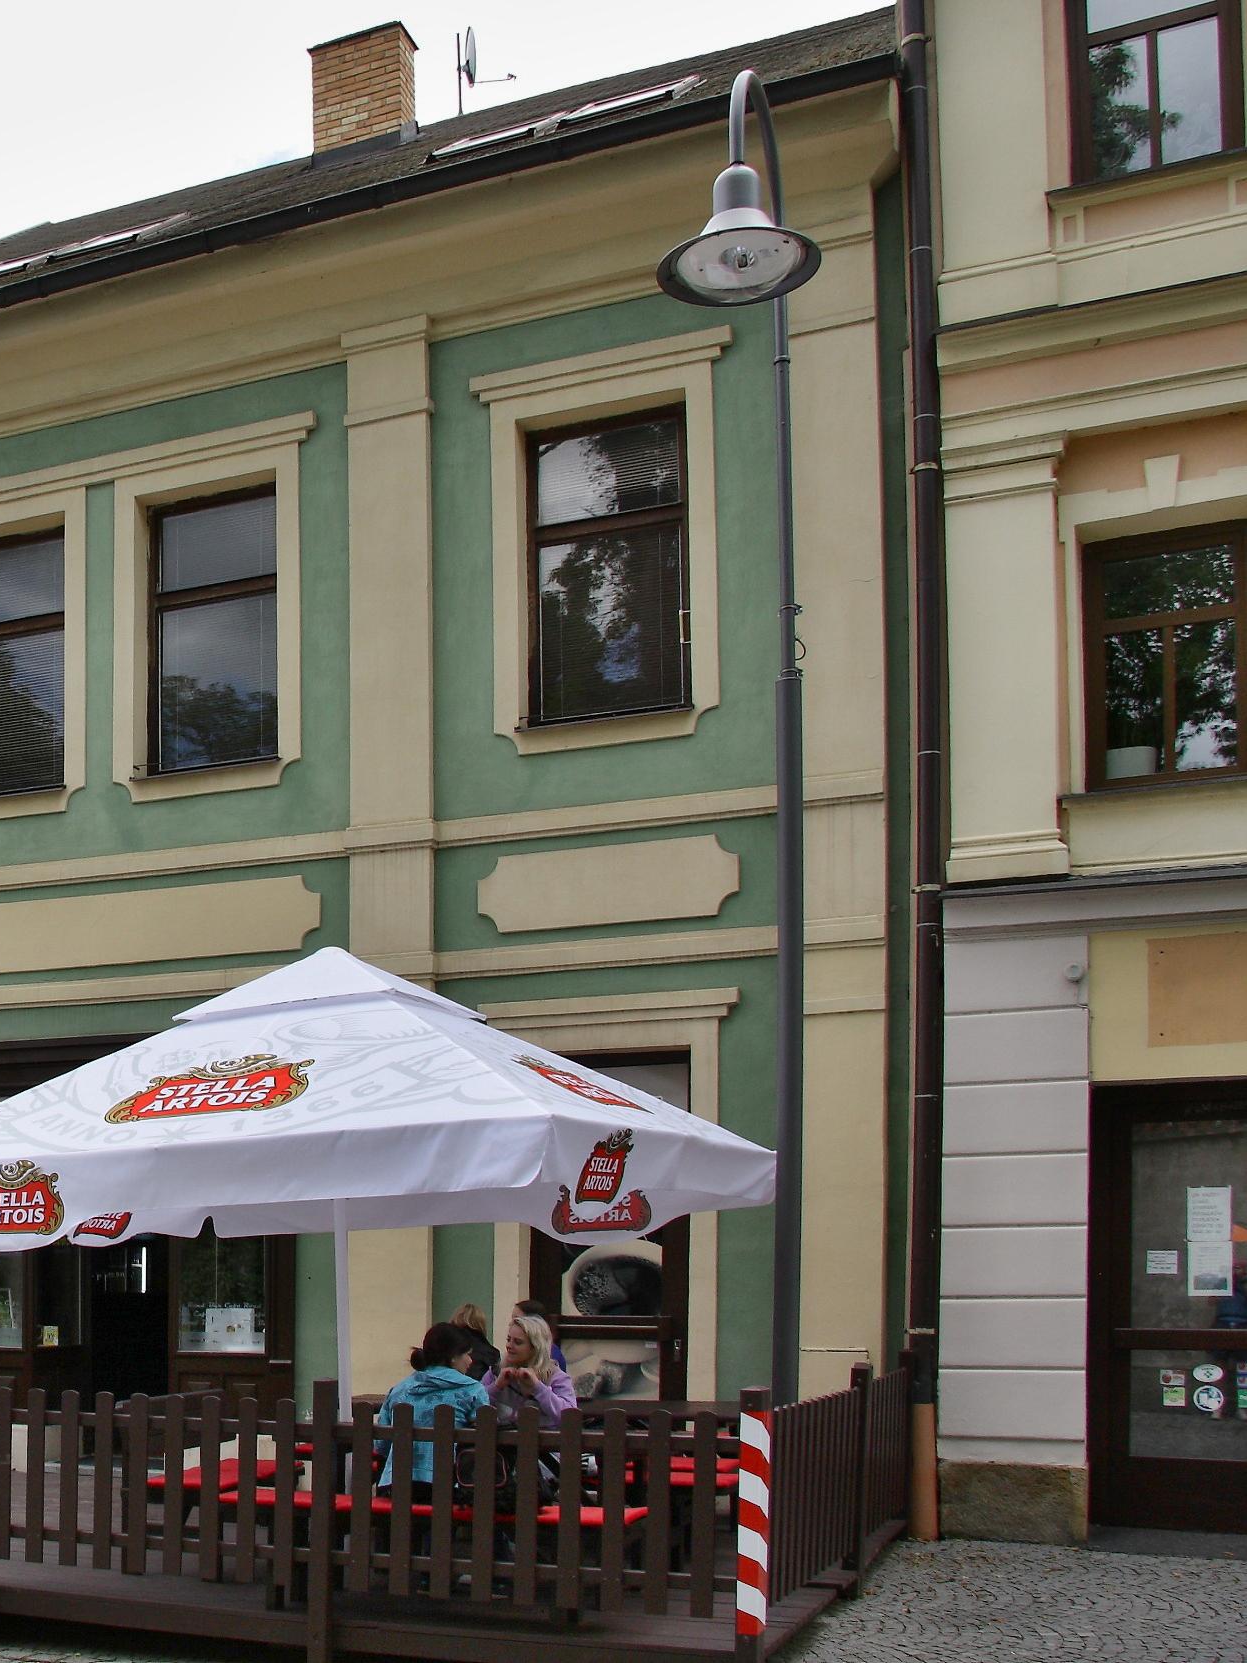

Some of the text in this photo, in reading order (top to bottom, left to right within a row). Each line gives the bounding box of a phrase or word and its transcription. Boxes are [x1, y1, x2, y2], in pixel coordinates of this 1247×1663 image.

[155, 1076, 276, 1100] STELLA
[139, 1089, 271, 1113] ARTOIS
[588, 1156, 620, 1174] STELLA
[582, 1174, 615, 1191] ARTOIS
